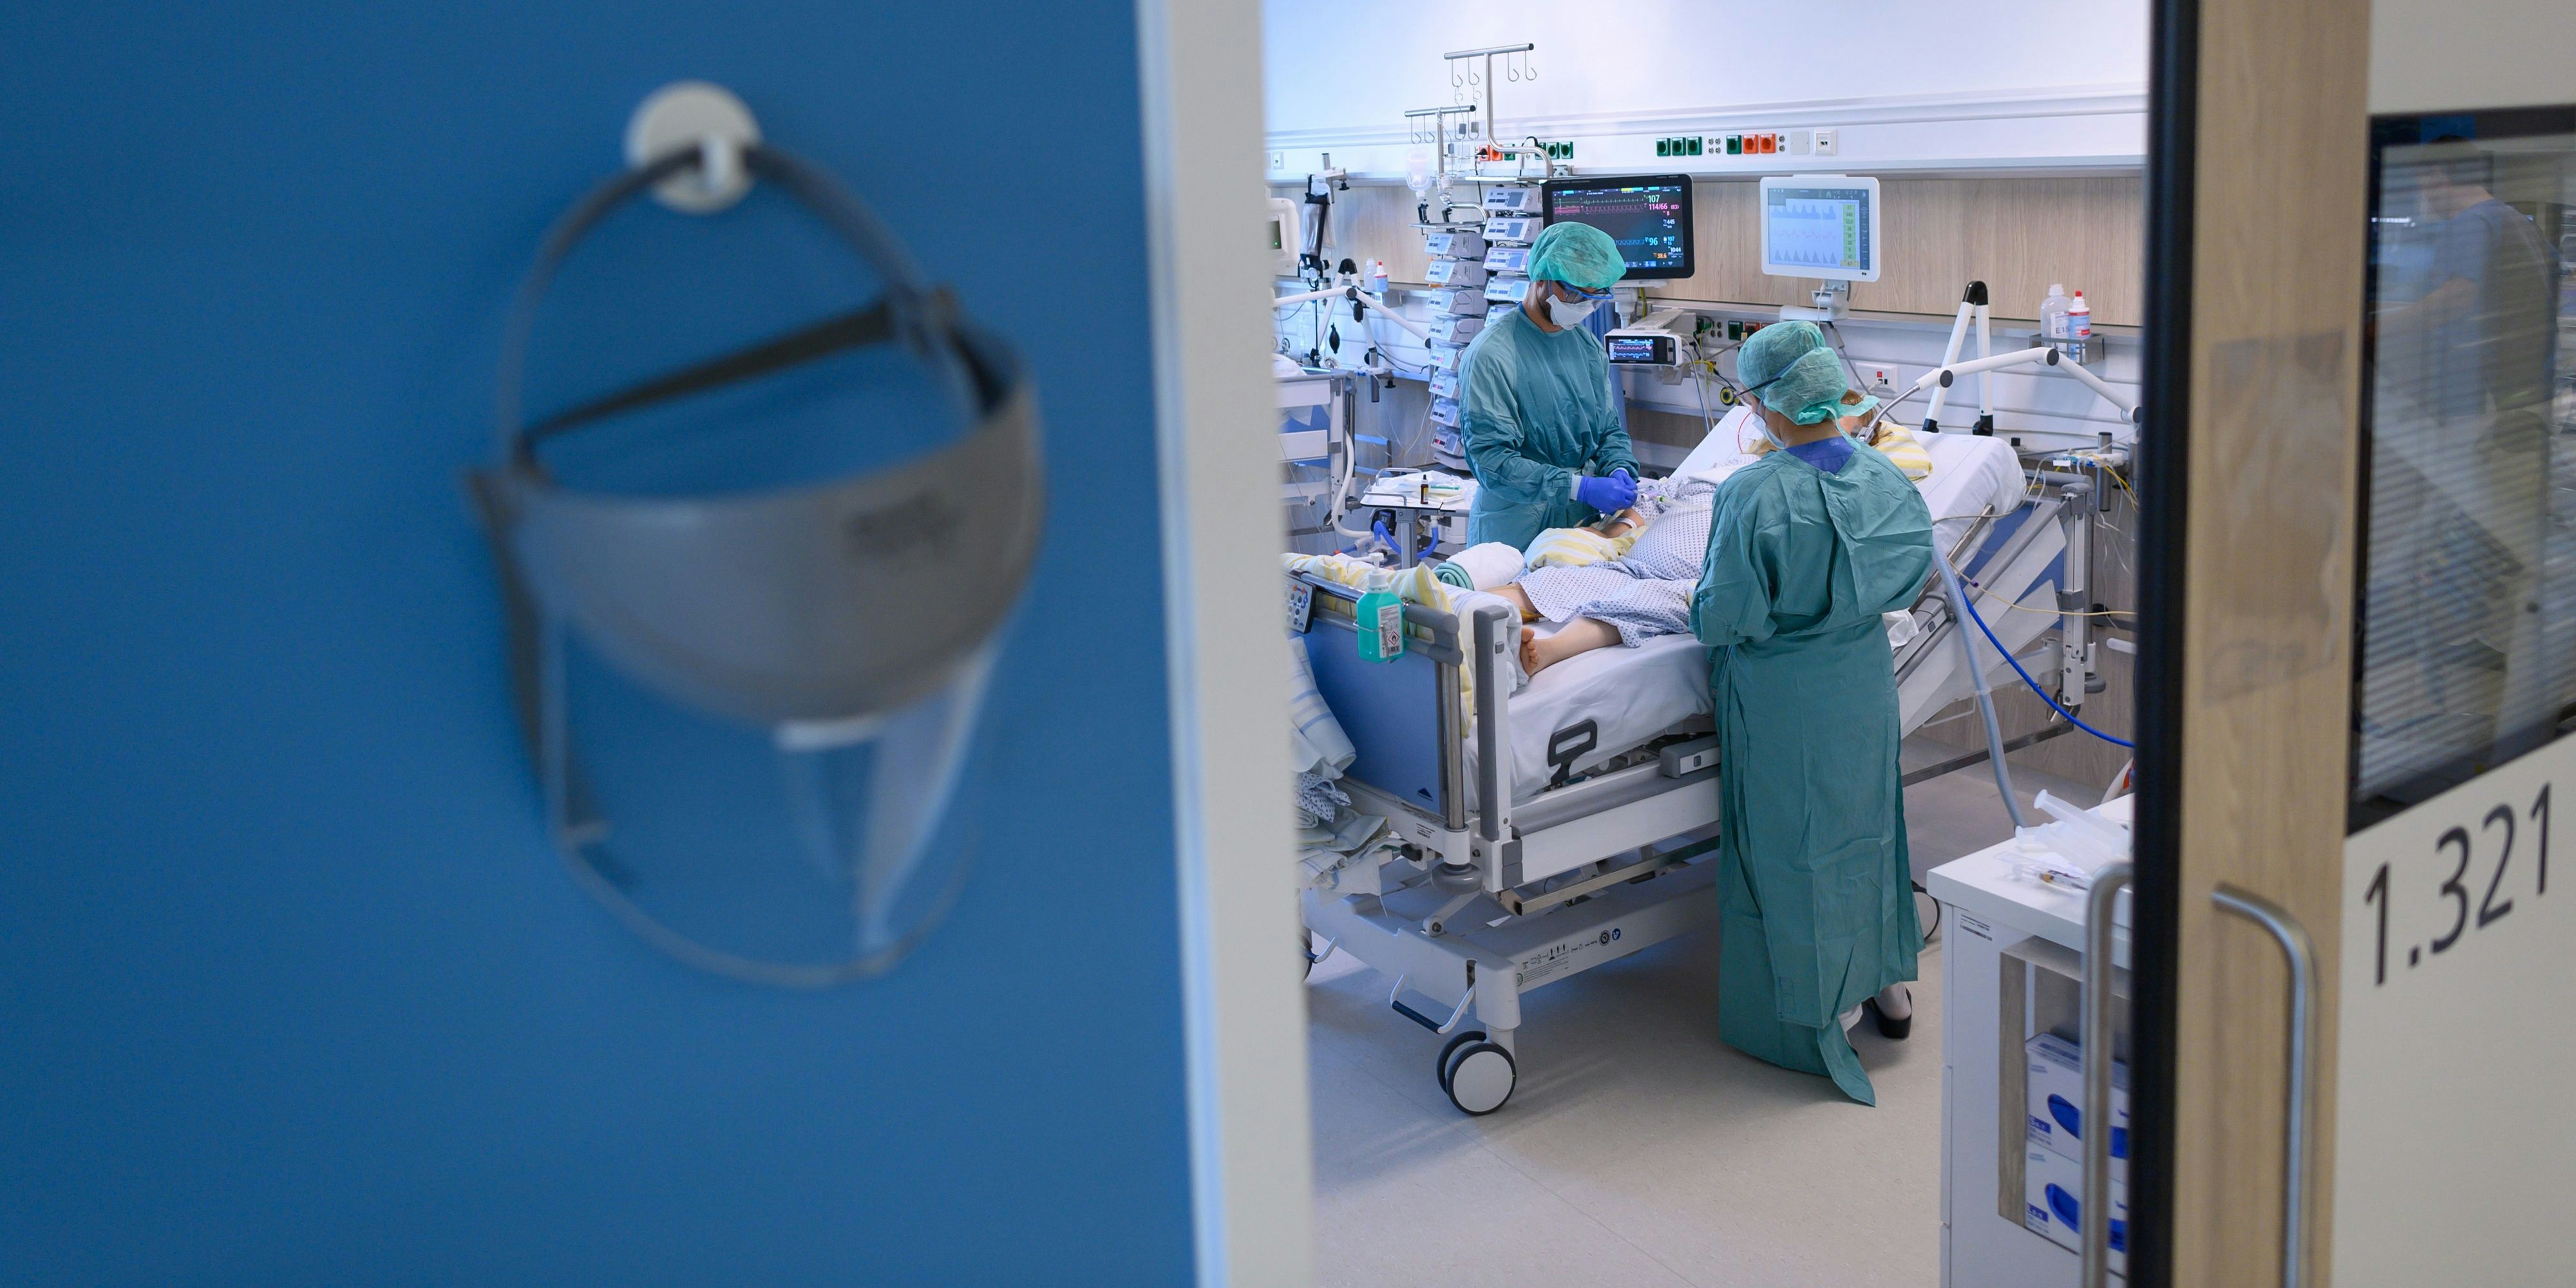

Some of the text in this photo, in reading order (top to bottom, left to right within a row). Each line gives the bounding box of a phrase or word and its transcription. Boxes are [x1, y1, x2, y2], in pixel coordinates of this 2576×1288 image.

[1649, 194, 1660, 203] 107
[1649, 237, 1658, 246] 96
[2365, 782, 2552, 987] 1.321
